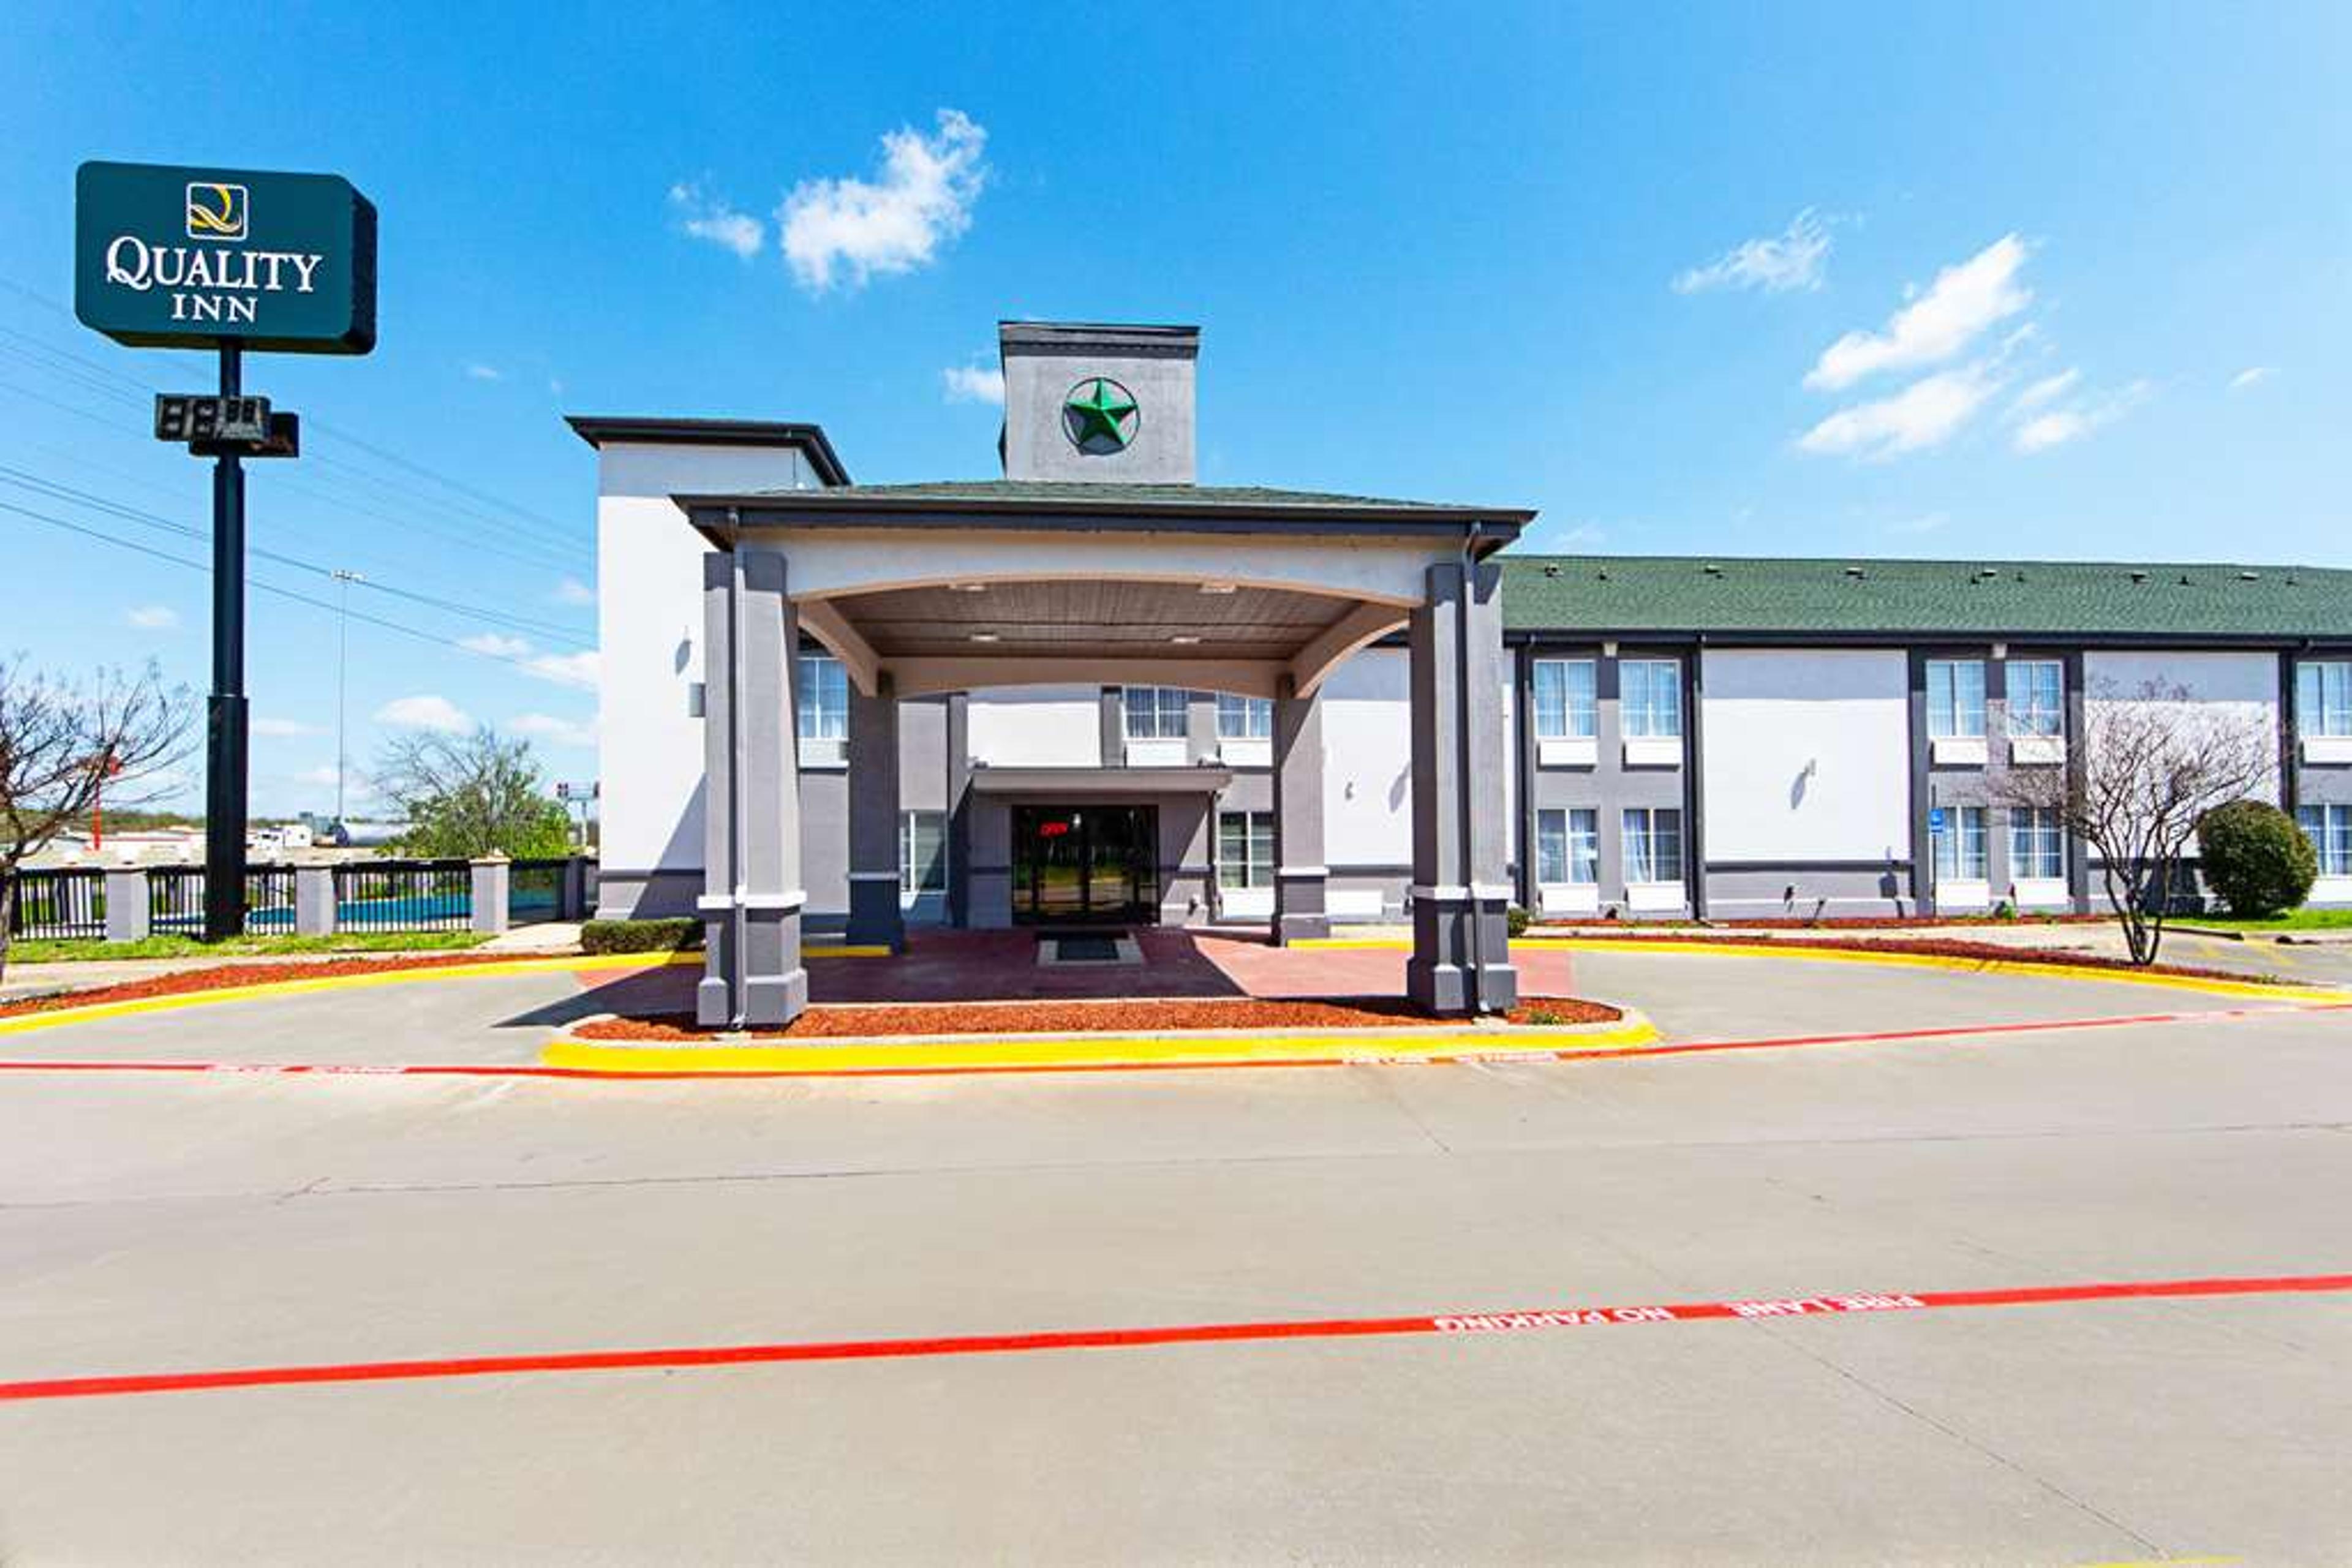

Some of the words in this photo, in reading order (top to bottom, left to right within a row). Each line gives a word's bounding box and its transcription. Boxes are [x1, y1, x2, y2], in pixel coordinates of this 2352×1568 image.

[107, 236, 322, 292] QUALITY
[171, 294, 258, 323] INN
[1434, 1310, 1610, 1332] PARKING
[1613, 1306, 1675, 1323] NO
